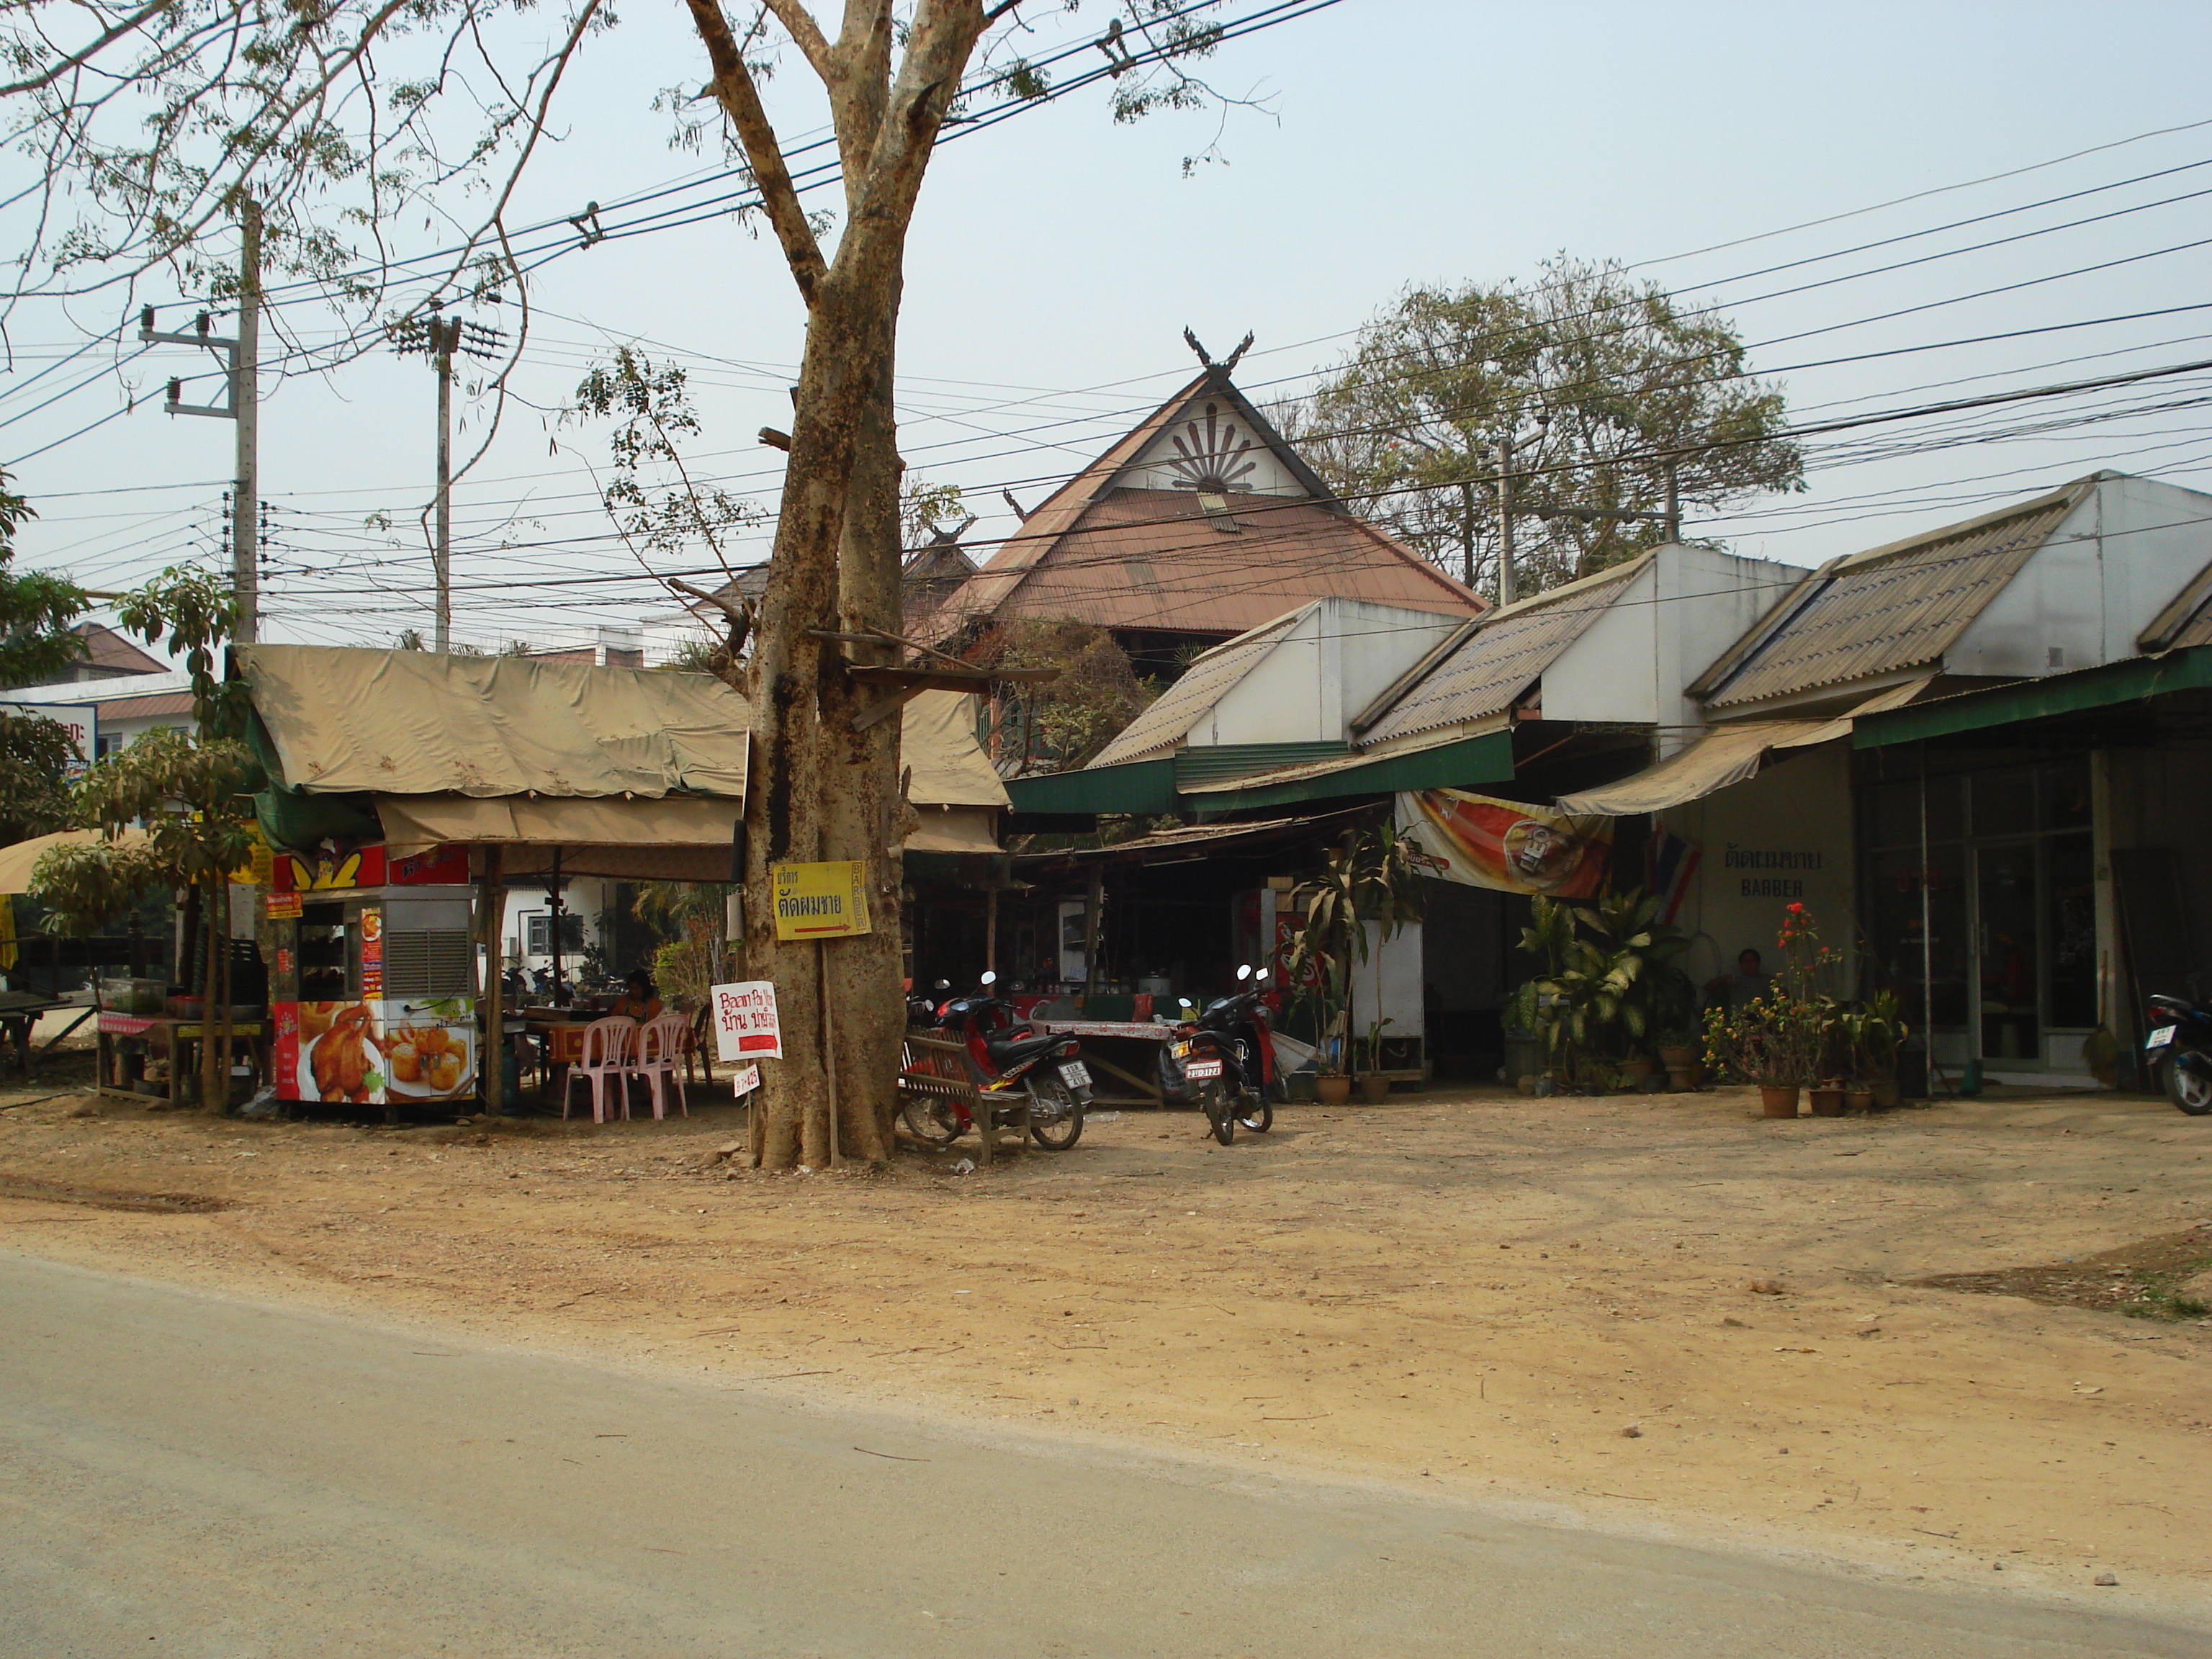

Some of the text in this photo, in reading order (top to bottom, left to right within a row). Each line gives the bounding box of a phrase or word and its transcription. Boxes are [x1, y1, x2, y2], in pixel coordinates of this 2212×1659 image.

[1519, 827, 1551, 873] LEO
[1725, 842, 1822, 870] ตัดผมชาย
[777, 867, 799, 885] บริการ
[1741, 878, 1803, 897] BARBER
[778, 888, 842, 917] ตัดผมชาย
[853, 864, 865, 927] BARBER
[719, 992, 751, 1010] Baan
[721, 1009, 748, 1032] บ้าน
